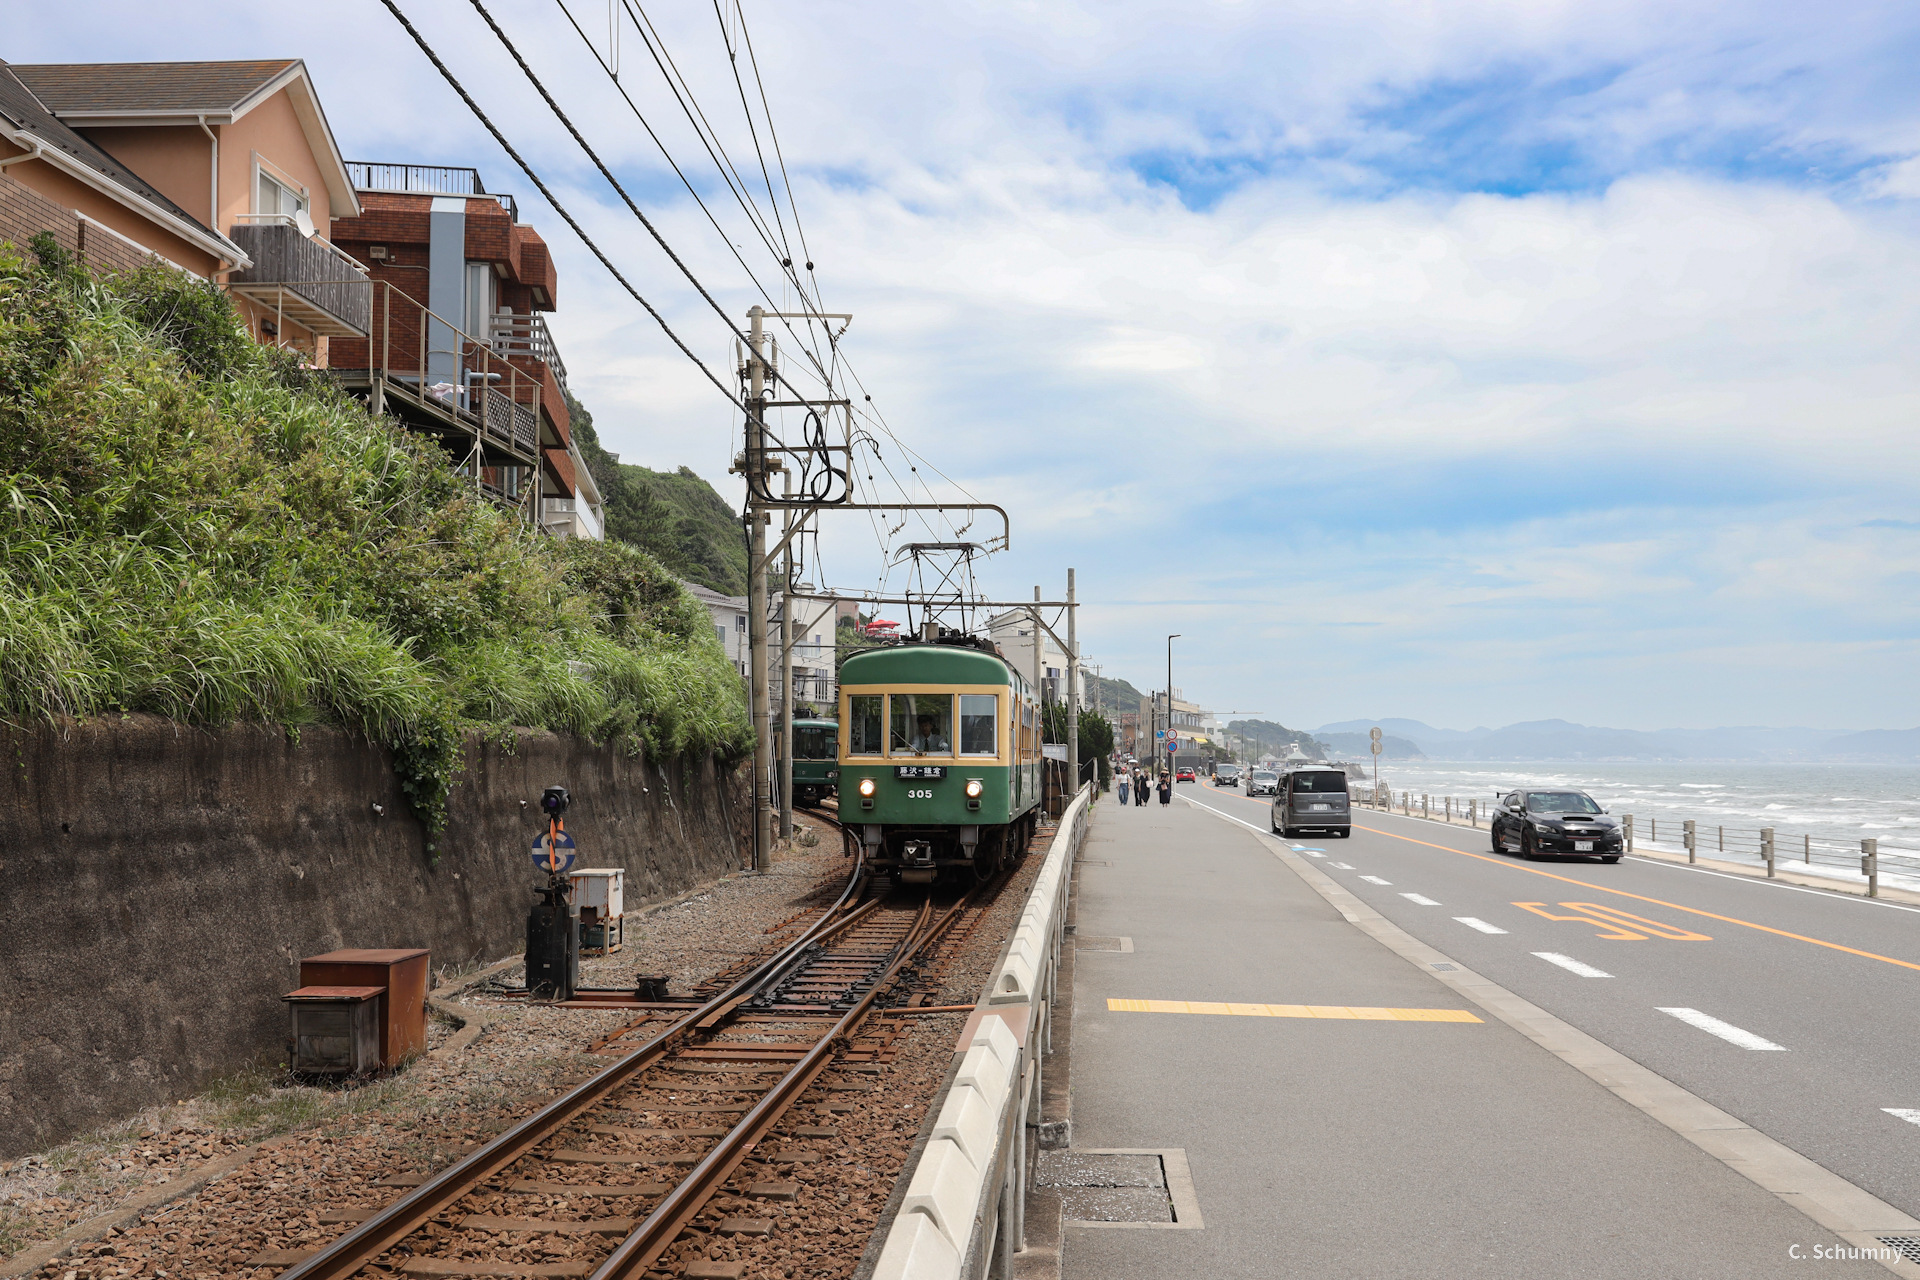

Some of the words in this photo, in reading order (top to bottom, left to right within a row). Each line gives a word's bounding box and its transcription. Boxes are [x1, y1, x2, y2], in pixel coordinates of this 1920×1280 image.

[907, 789, 933, 799] 305
[540, 832, 568, 872] S
[1510, 902, 1714, 941] 50
